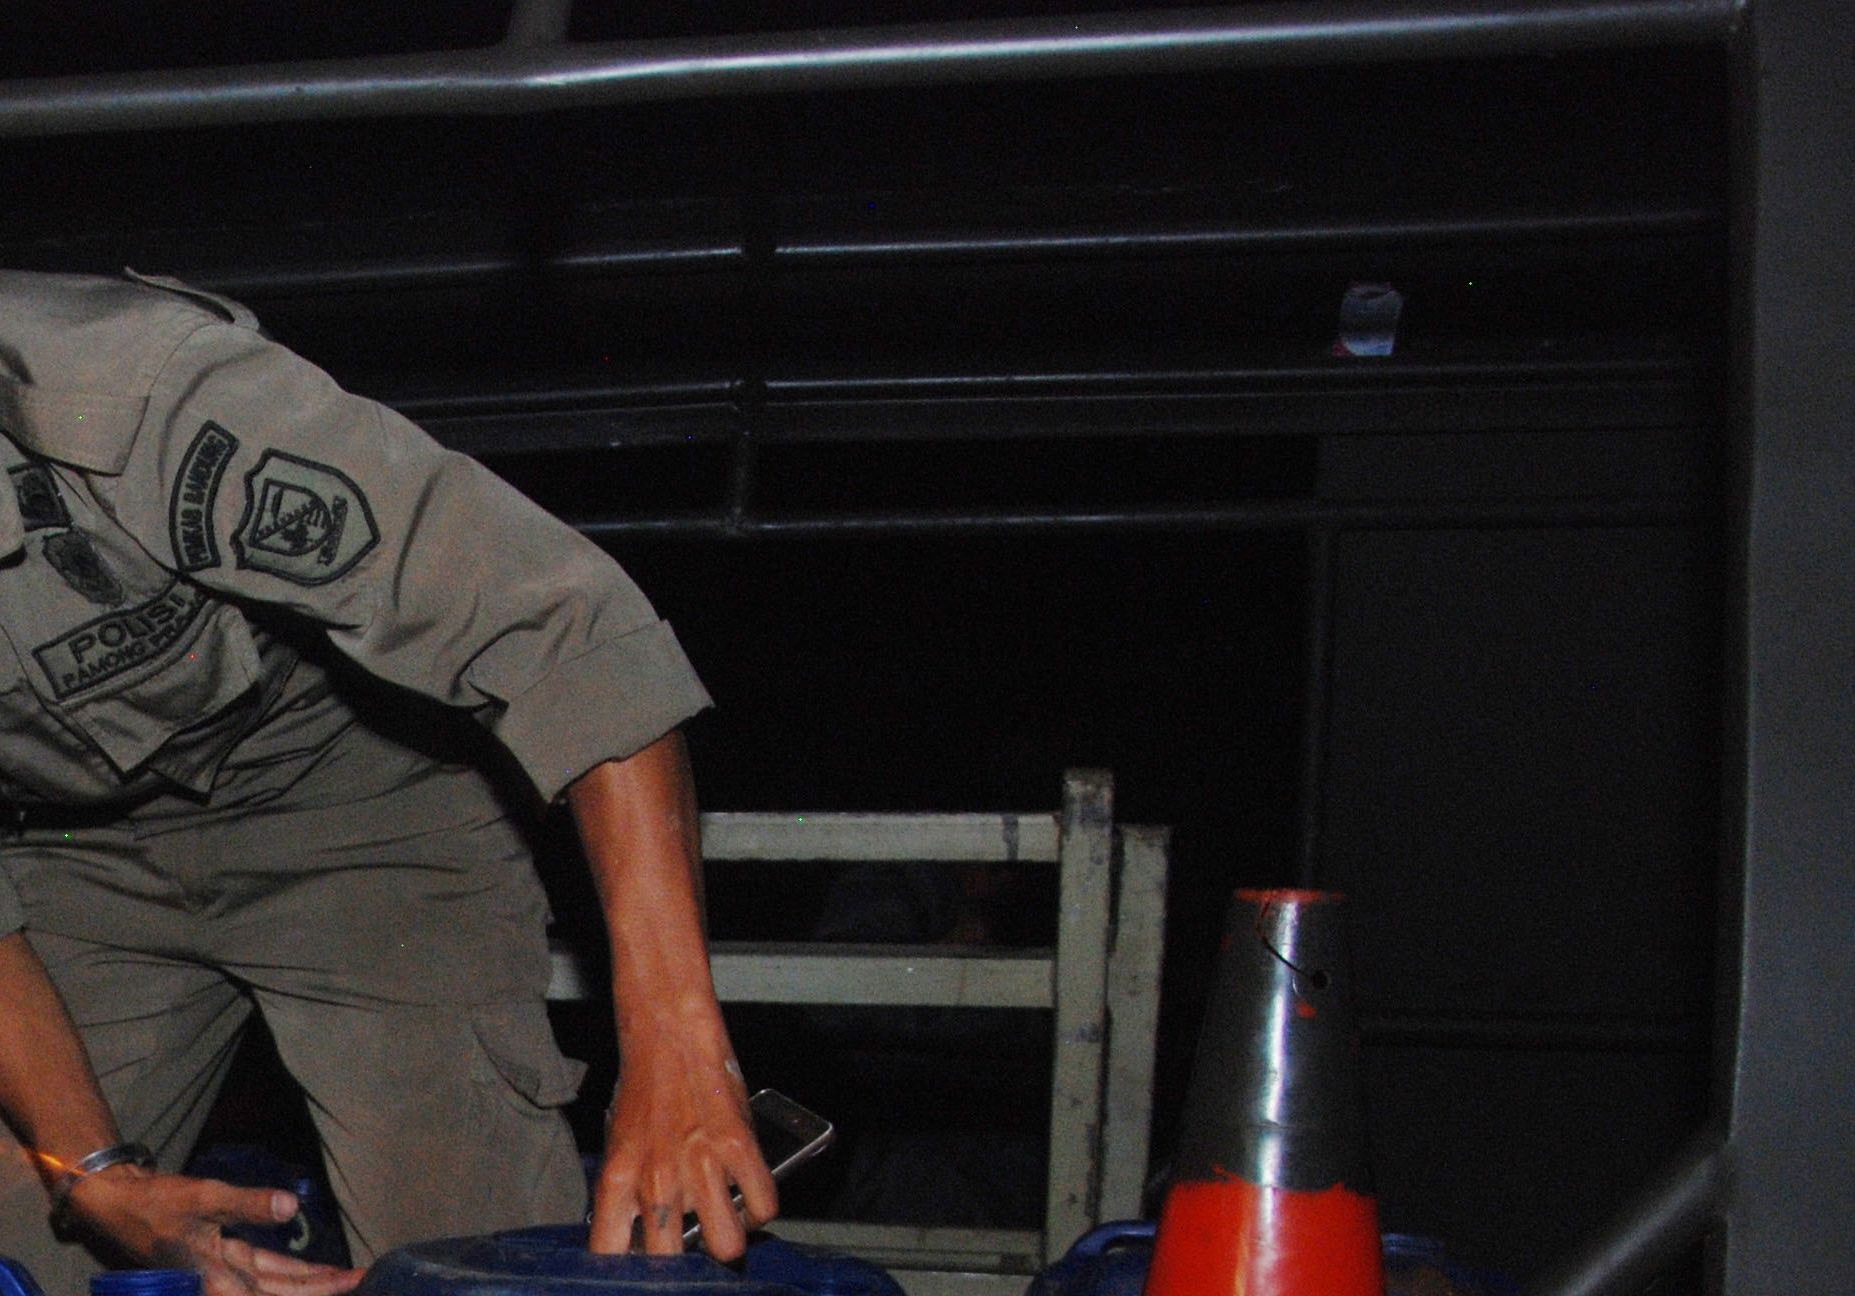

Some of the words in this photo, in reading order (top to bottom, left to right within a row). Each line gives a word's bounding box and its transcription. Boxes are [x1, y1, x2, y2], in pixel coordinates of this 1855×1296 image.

[183, 434, 229, 506] BANDUNG
[67, 591, 187, 664] POLISI
[60, 639, 148, 690] PAMONG
